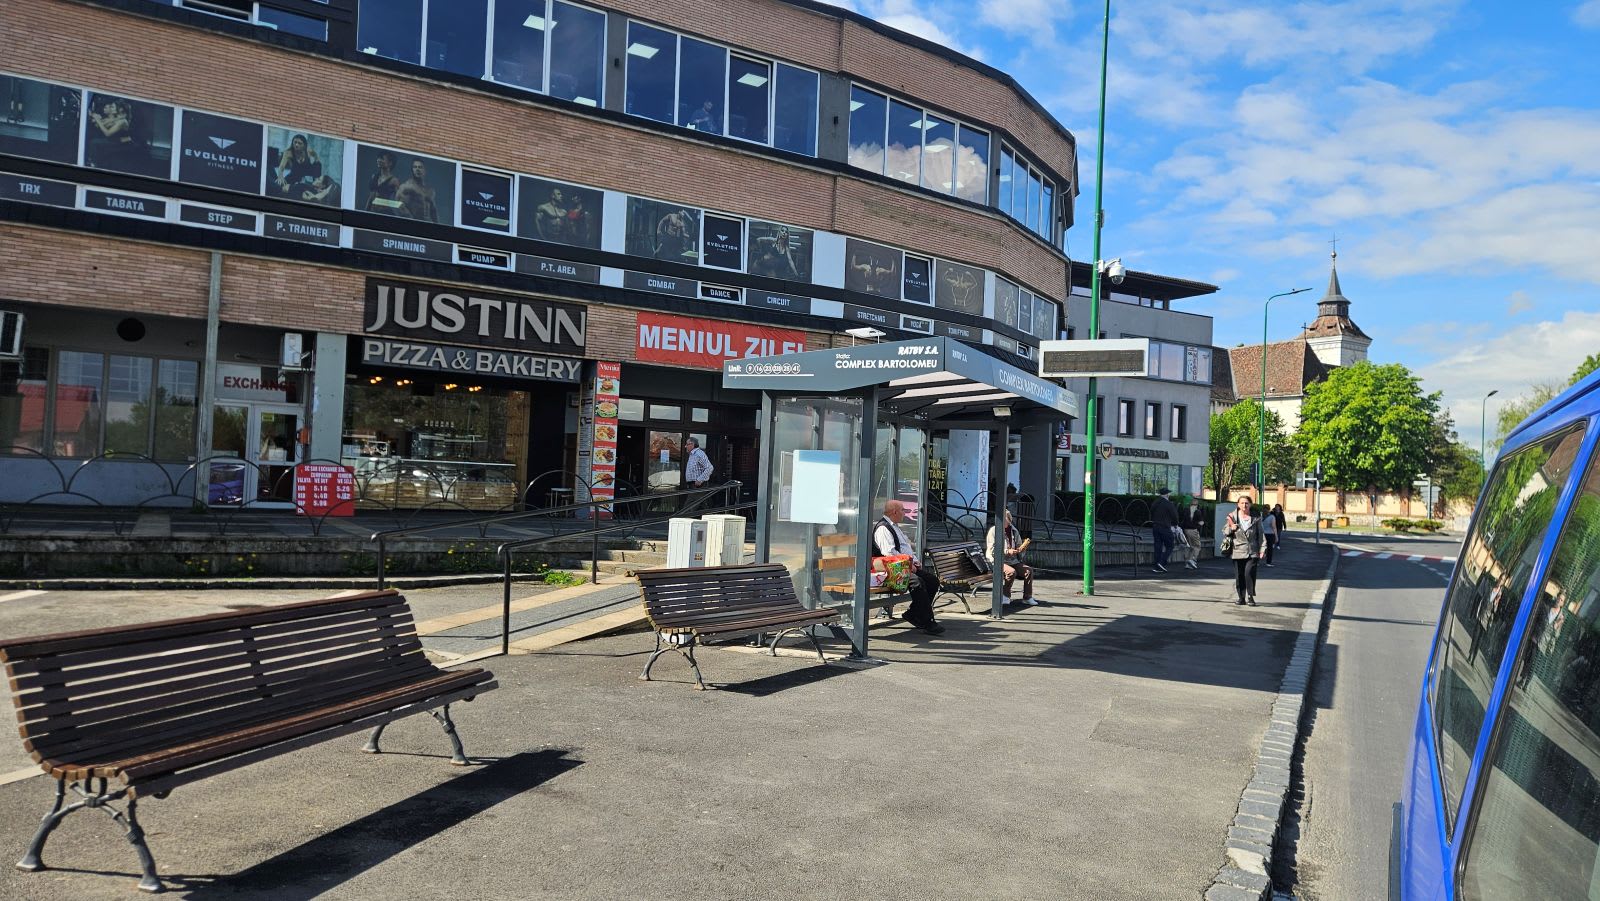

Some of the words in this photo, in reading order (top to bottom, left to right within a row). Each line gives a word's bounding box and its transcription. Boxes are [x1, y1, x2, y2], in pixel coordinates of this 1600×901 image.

[184, 148, 257, 168] EVOLUTION
[208, 162, 234, 170] FITNESS
[19, 182, 41, 195] TRX
[106, 196, 144, 212] TABATA
[466, 199, 506, 212] EVOLUTION
[208, 212, 233, 224] STEP
[276, 222, 286, 232] P.
[288, 224, 328, 238] TRAINER
[382, 238, 426, 254] SPINNING
[471, 254, 496, 264] PUMP
[540, 262, 556, 272] P.T.
[557, 264, 576, 276] AREA
[648, 278, 676, 290] COMBAT
[710, 288, 731, 298] DANCE
[766, 296, 790, 306] CIRCUIT
[366, 284, 586, 346] JUSTINN
[639, 324, 738, 358] MENIUL
[898, 346, 922, 355] RATBV
[924, 346, 939, 355] S.A.
[363, 340, 448, 369] PIZZA
[450, 350, 472, 370] &
[475, 352, 582, 380] BAKERY
[835, 360, 876, 368] COMPLEX
[878, 360, 937, 368] BARTOLOMEU
[223, 376, 296, 392] EXCHANGE
[1072, 444, 1100, 454] BANA
[1114, 447, 1169, 460] TRANSILVANIA
